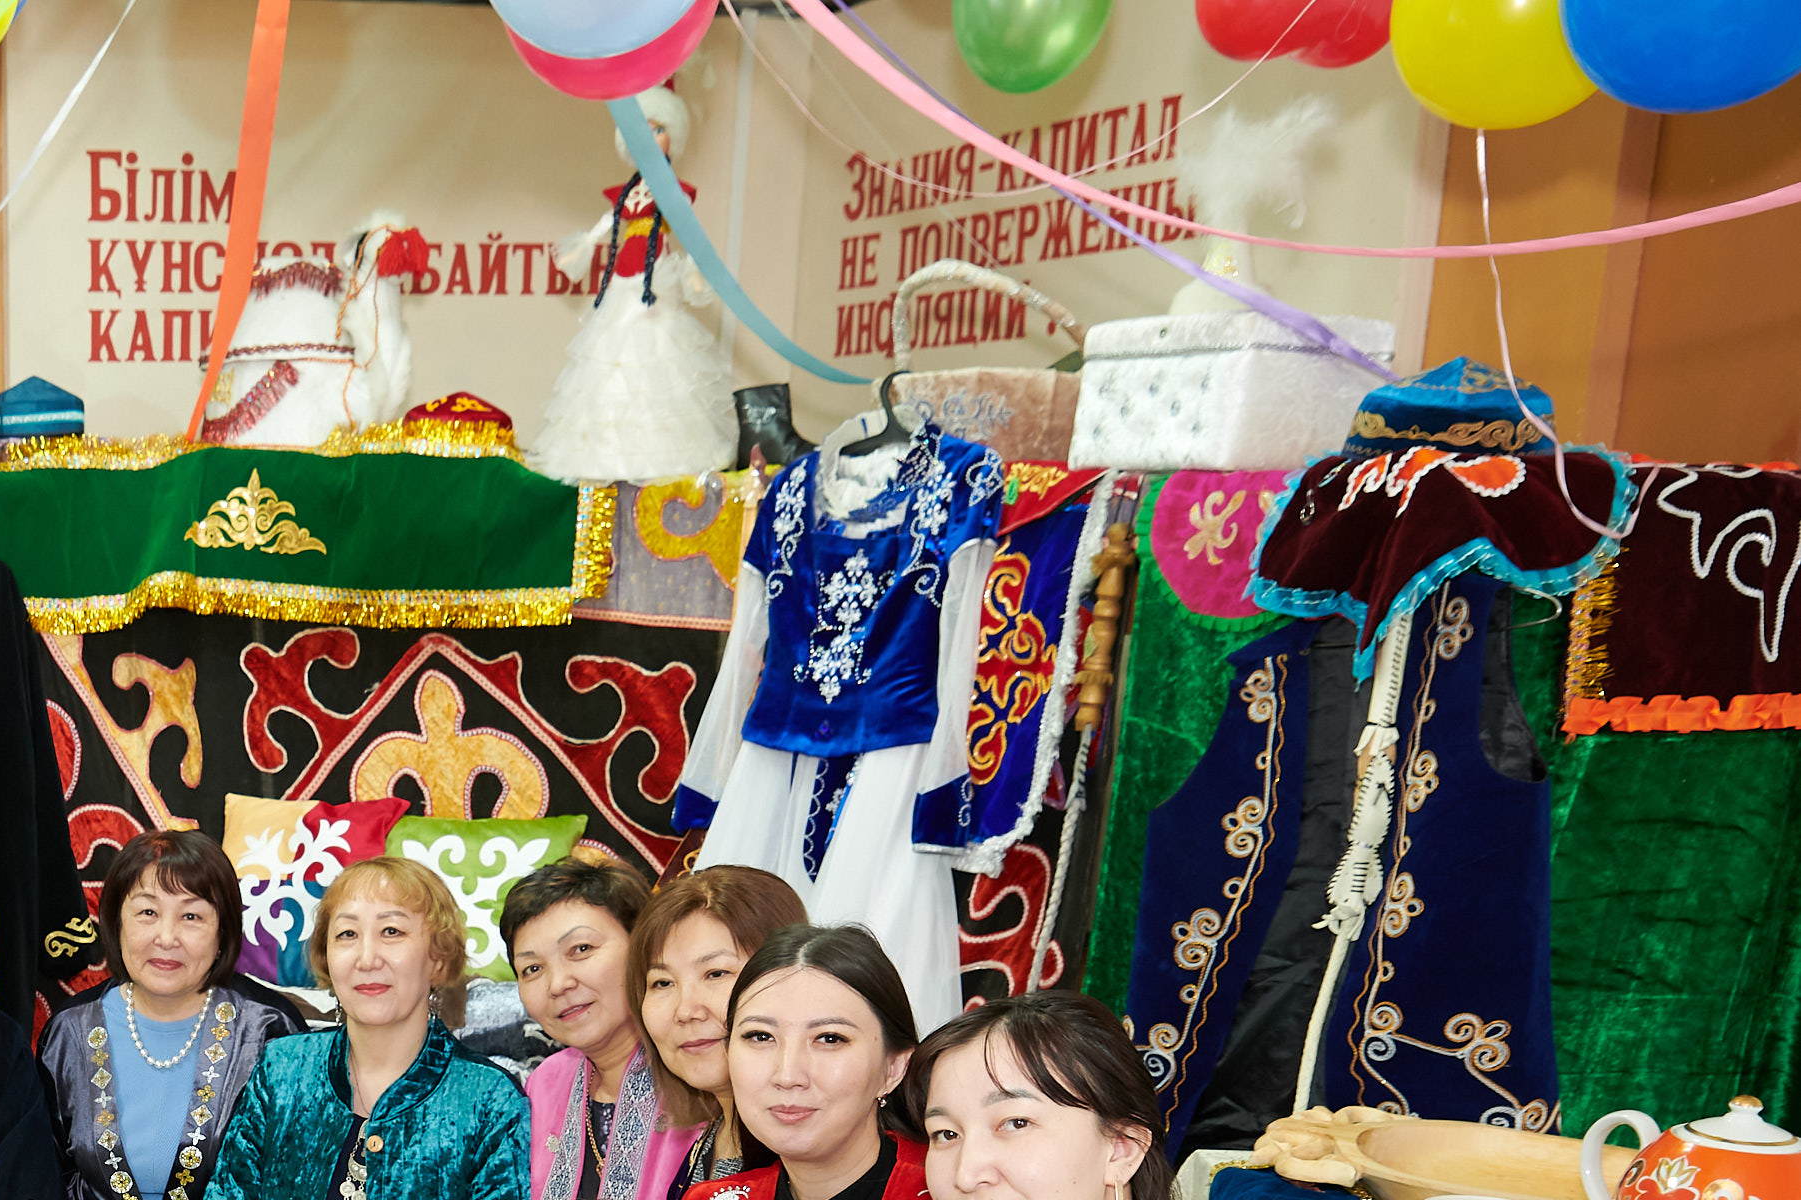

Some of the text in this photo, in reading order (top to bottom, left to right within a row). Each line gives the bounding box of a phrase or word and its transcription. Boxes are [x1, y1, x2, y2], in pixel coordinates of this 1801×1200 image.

[86, 150, 238, 224] Білім
[839, 177, 1198, 291] НЕ ПОДВЕРЖЕННЫ
